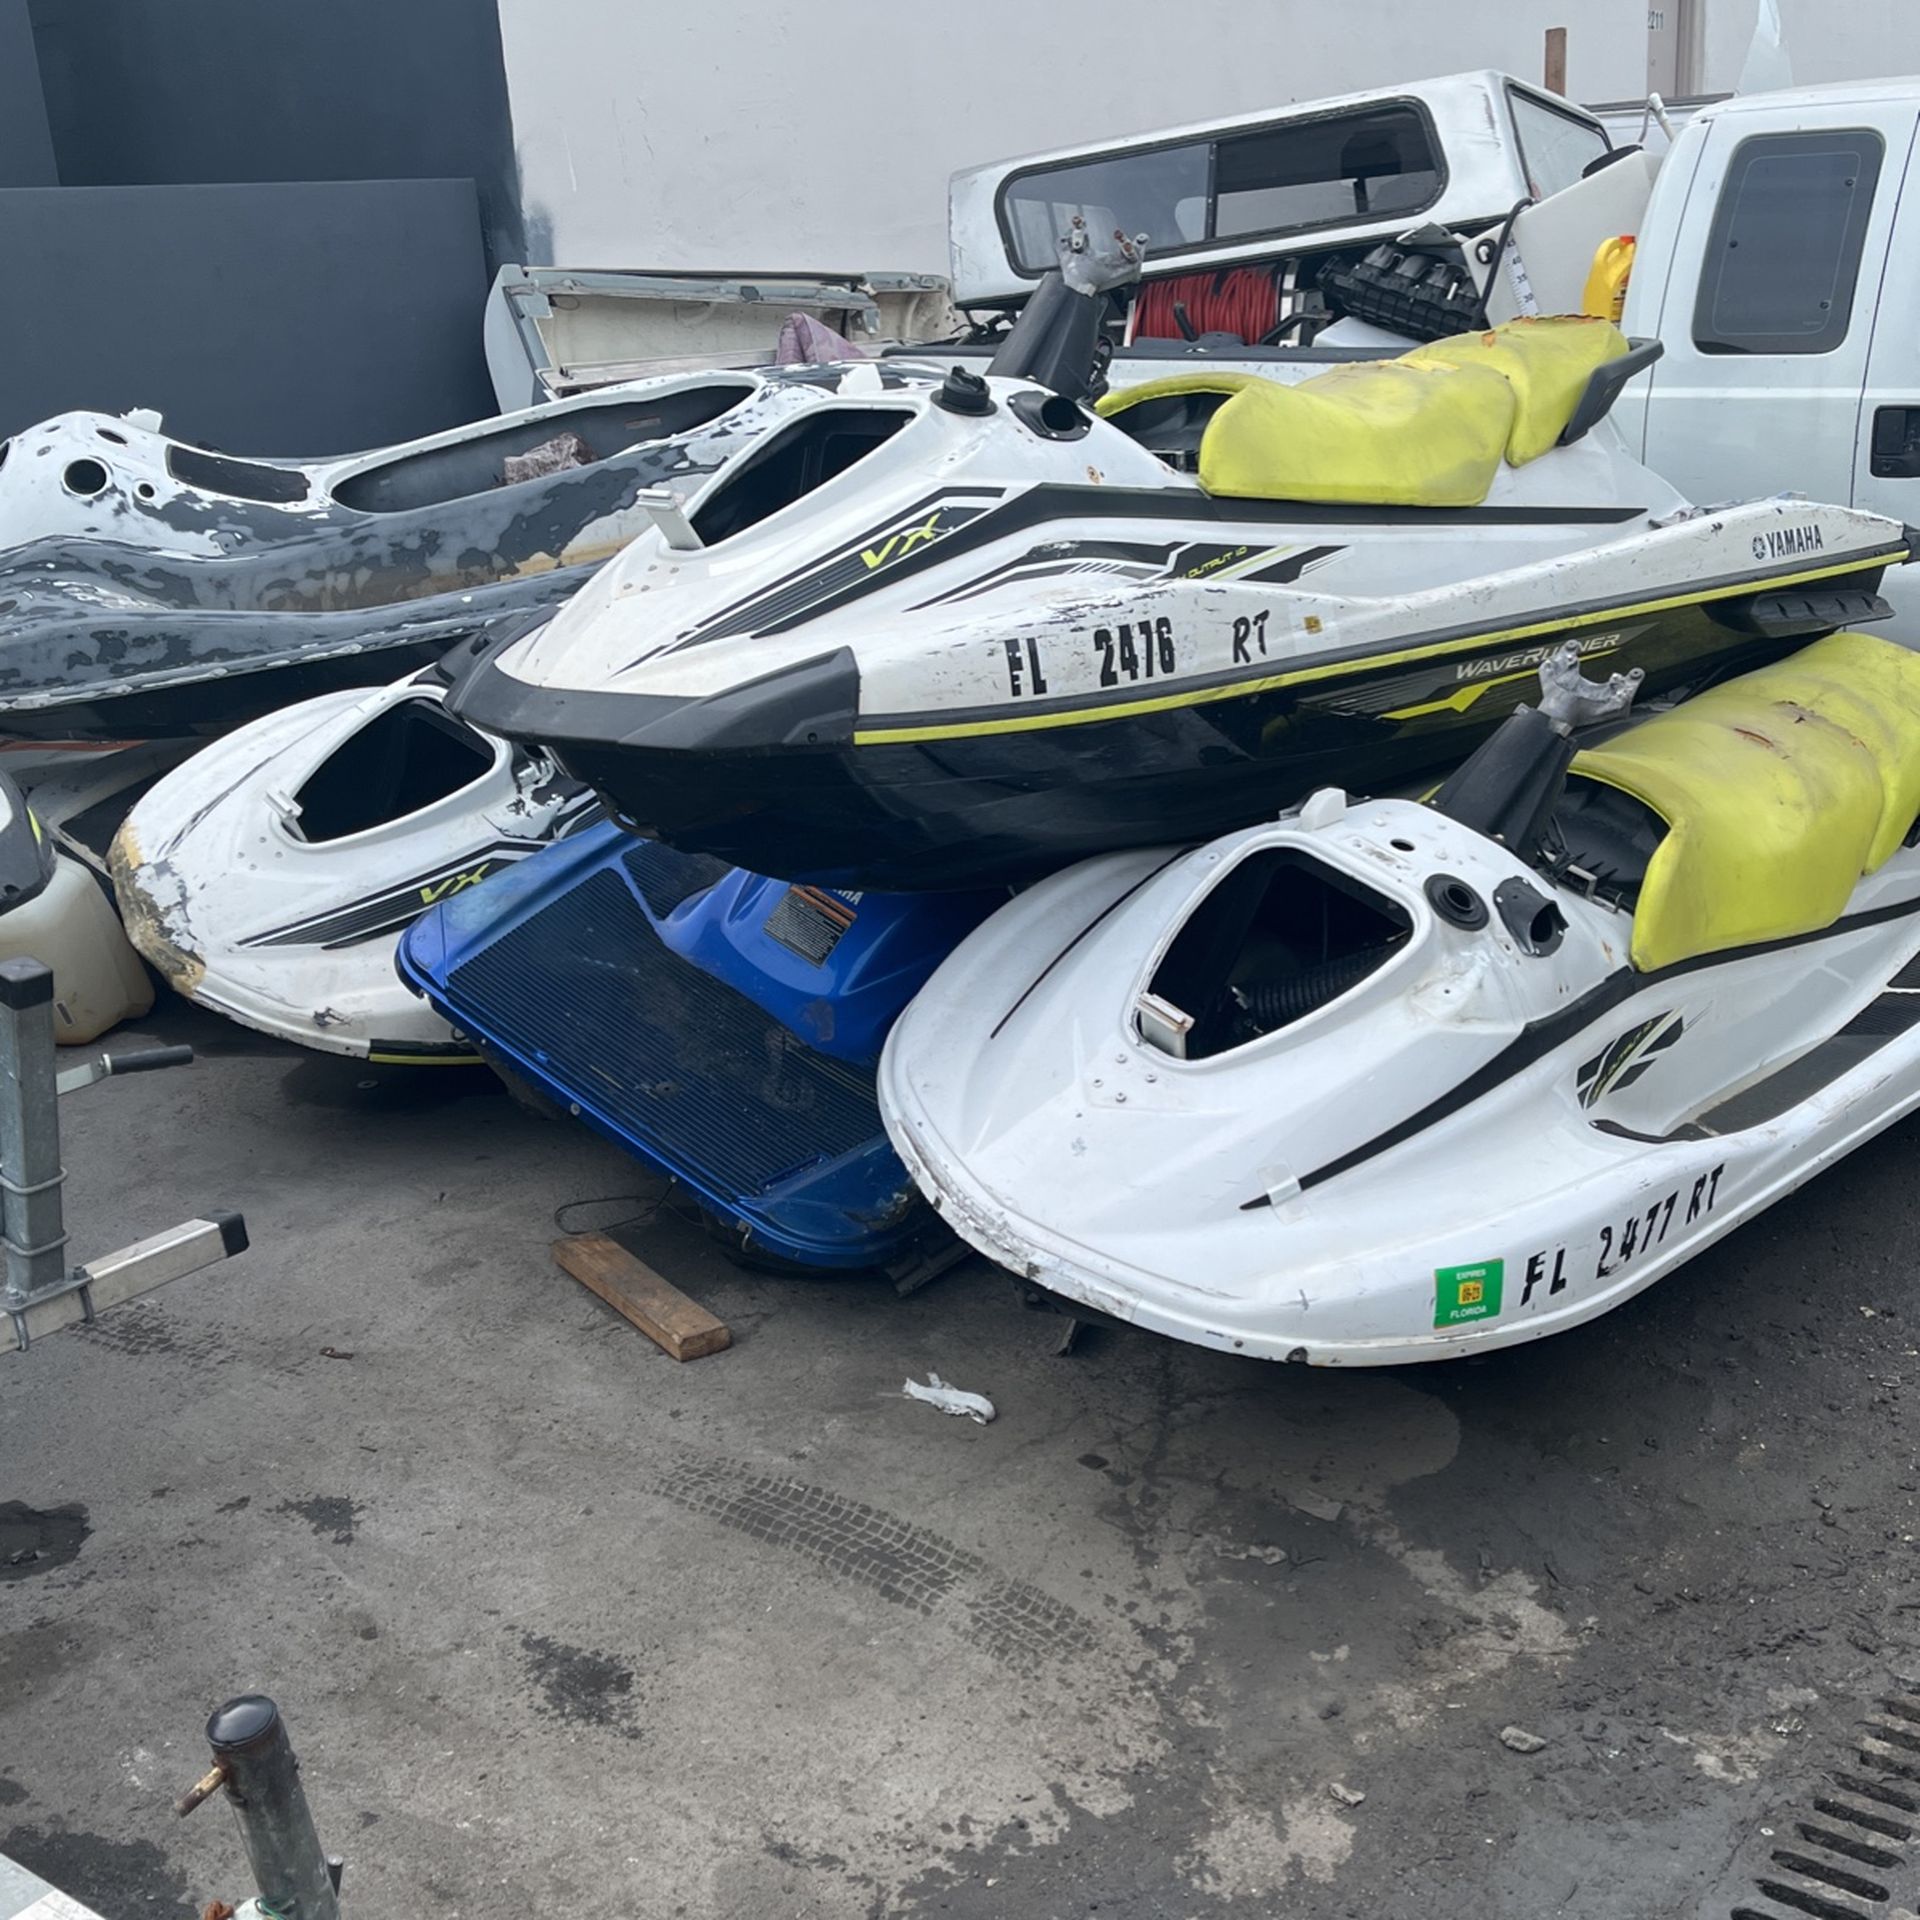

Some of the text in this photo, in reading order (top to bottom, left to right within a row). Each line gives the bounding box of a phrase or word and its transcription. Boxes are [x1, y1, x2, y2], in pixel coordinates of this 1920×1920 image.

[860, 511, 941, 569] VX
[1765, 524, 1823, 558] YAMAHA
[1004, 609, 1270, 696] FL 2476 RT
[1456, 633, 1621, 680] WAVERUNER
[420, 862, 490, 904] VX
[1520, 1163, 1725, 1306] FL 2477 RT
[1449, 1305, 1487, 1319] FLORIDA
